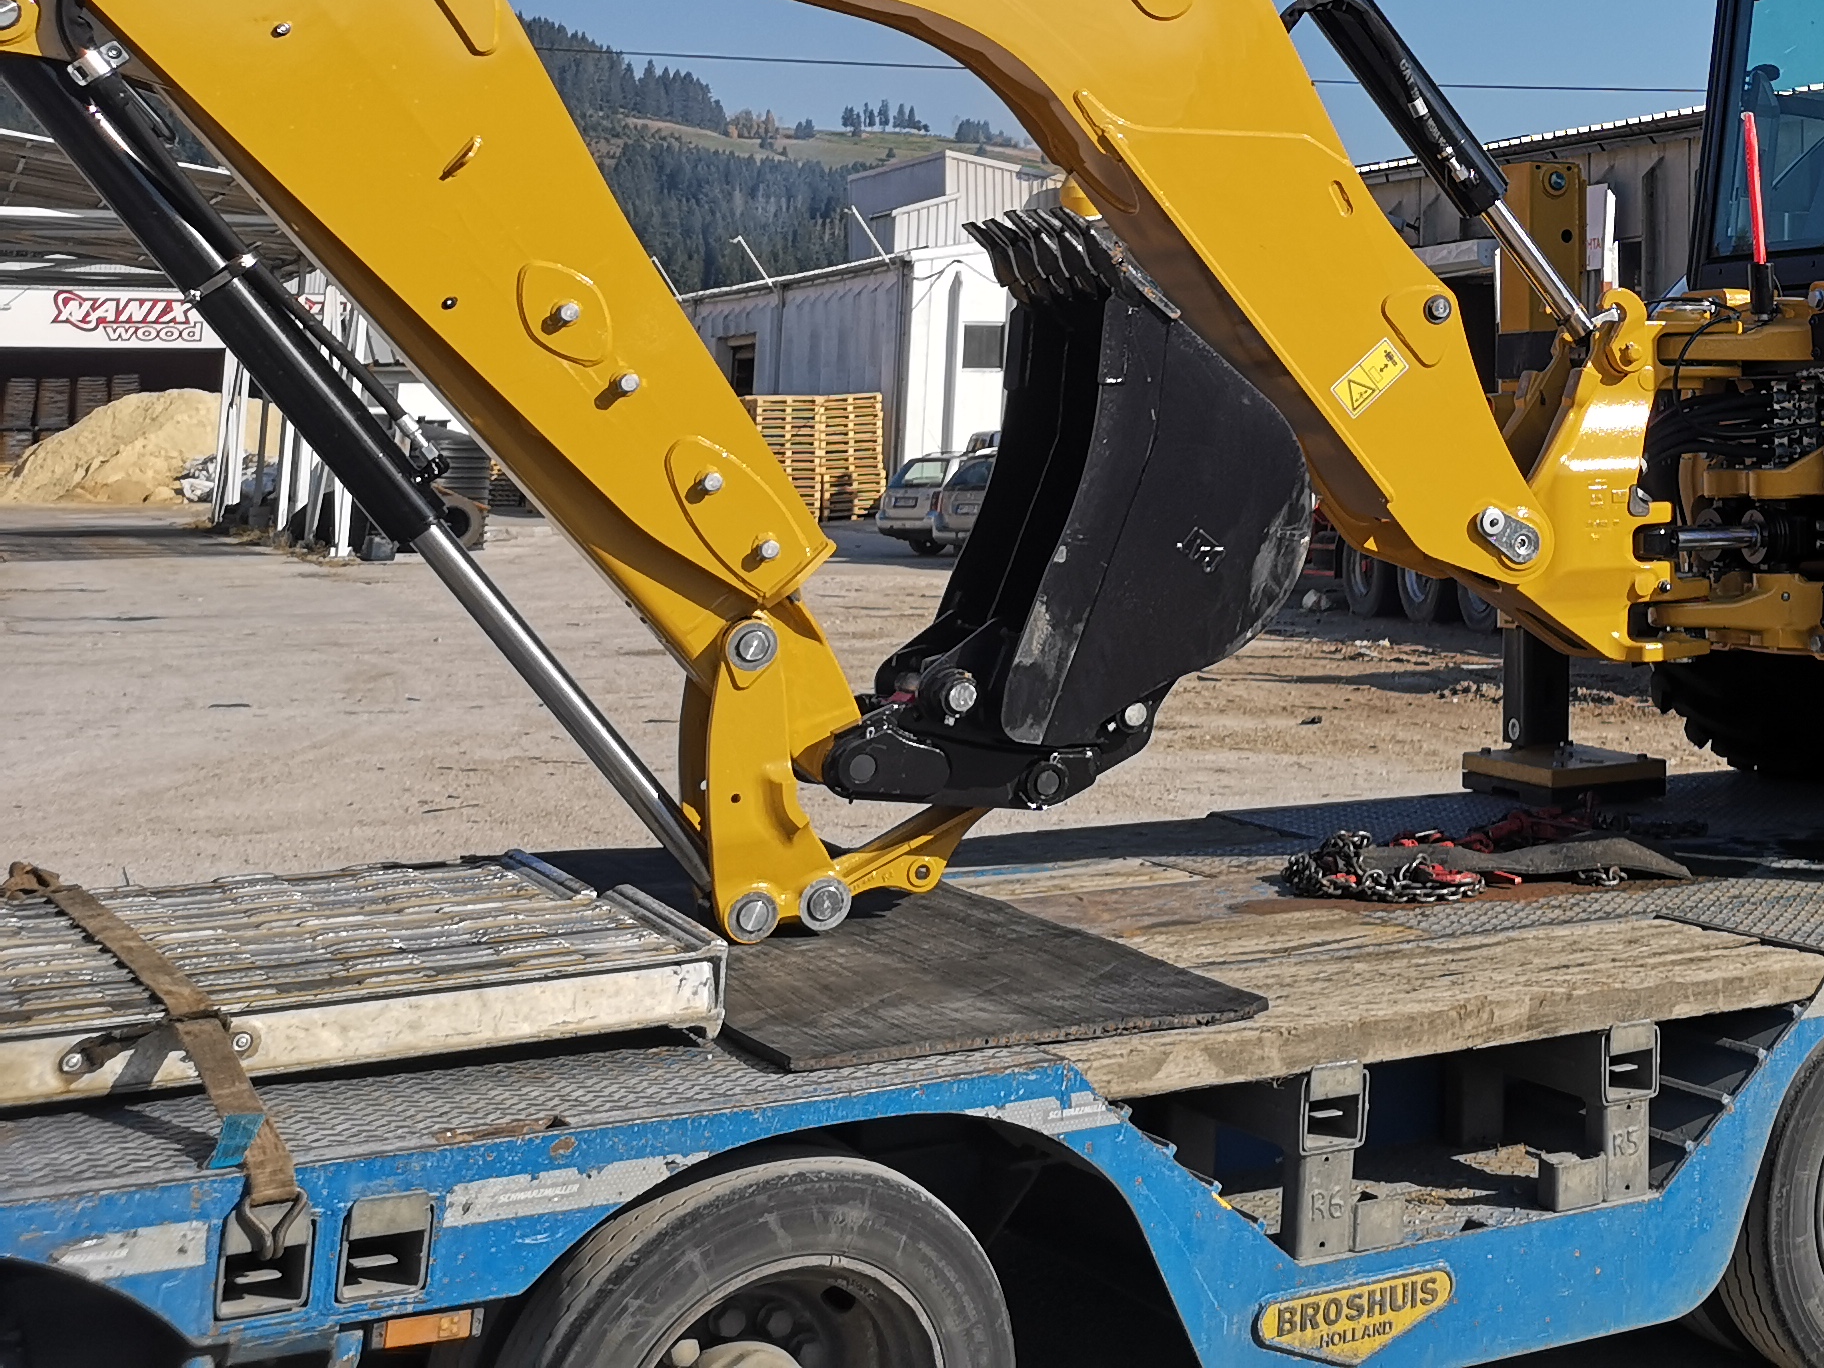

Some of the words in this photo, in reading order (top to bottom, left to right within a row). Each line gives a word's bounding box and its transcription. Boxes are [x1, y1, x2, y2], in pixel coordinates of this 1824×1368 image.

[51, 290, 197, 330] NANIX
[102, 322, 203, 342] wood
[1612, 1127, 1640, 1159] R5
[1309, 1188, 1346, 1222] R6
[1276, 1276, 1440, 1338] BROSHUIS
[1319, 1321, 1394, 1349] HOLLAND
